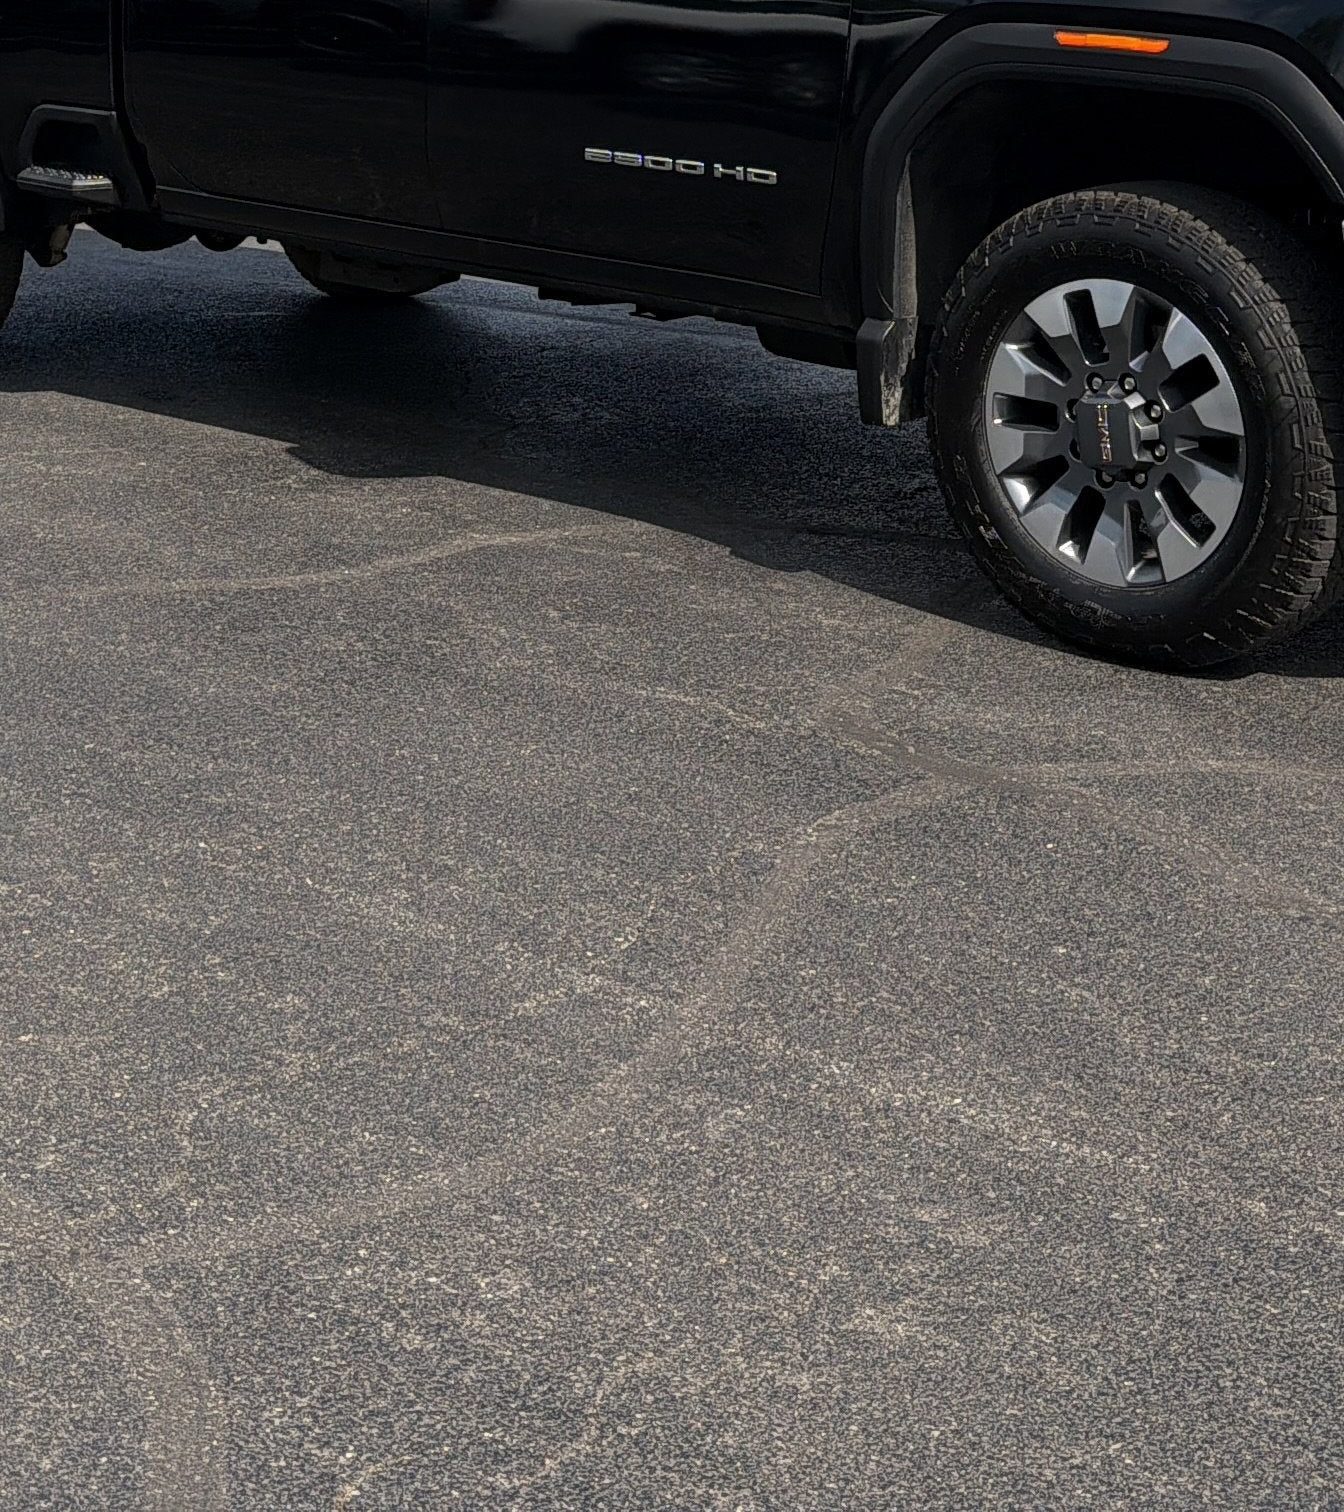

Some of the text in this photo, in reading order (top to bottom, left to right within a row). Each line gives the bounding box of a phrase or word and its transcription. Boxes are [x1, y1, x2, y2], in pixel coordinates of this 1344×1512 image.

[584, 147, 778, 185] 2500 HD
[1097, 404, 1113, 463] GMC
